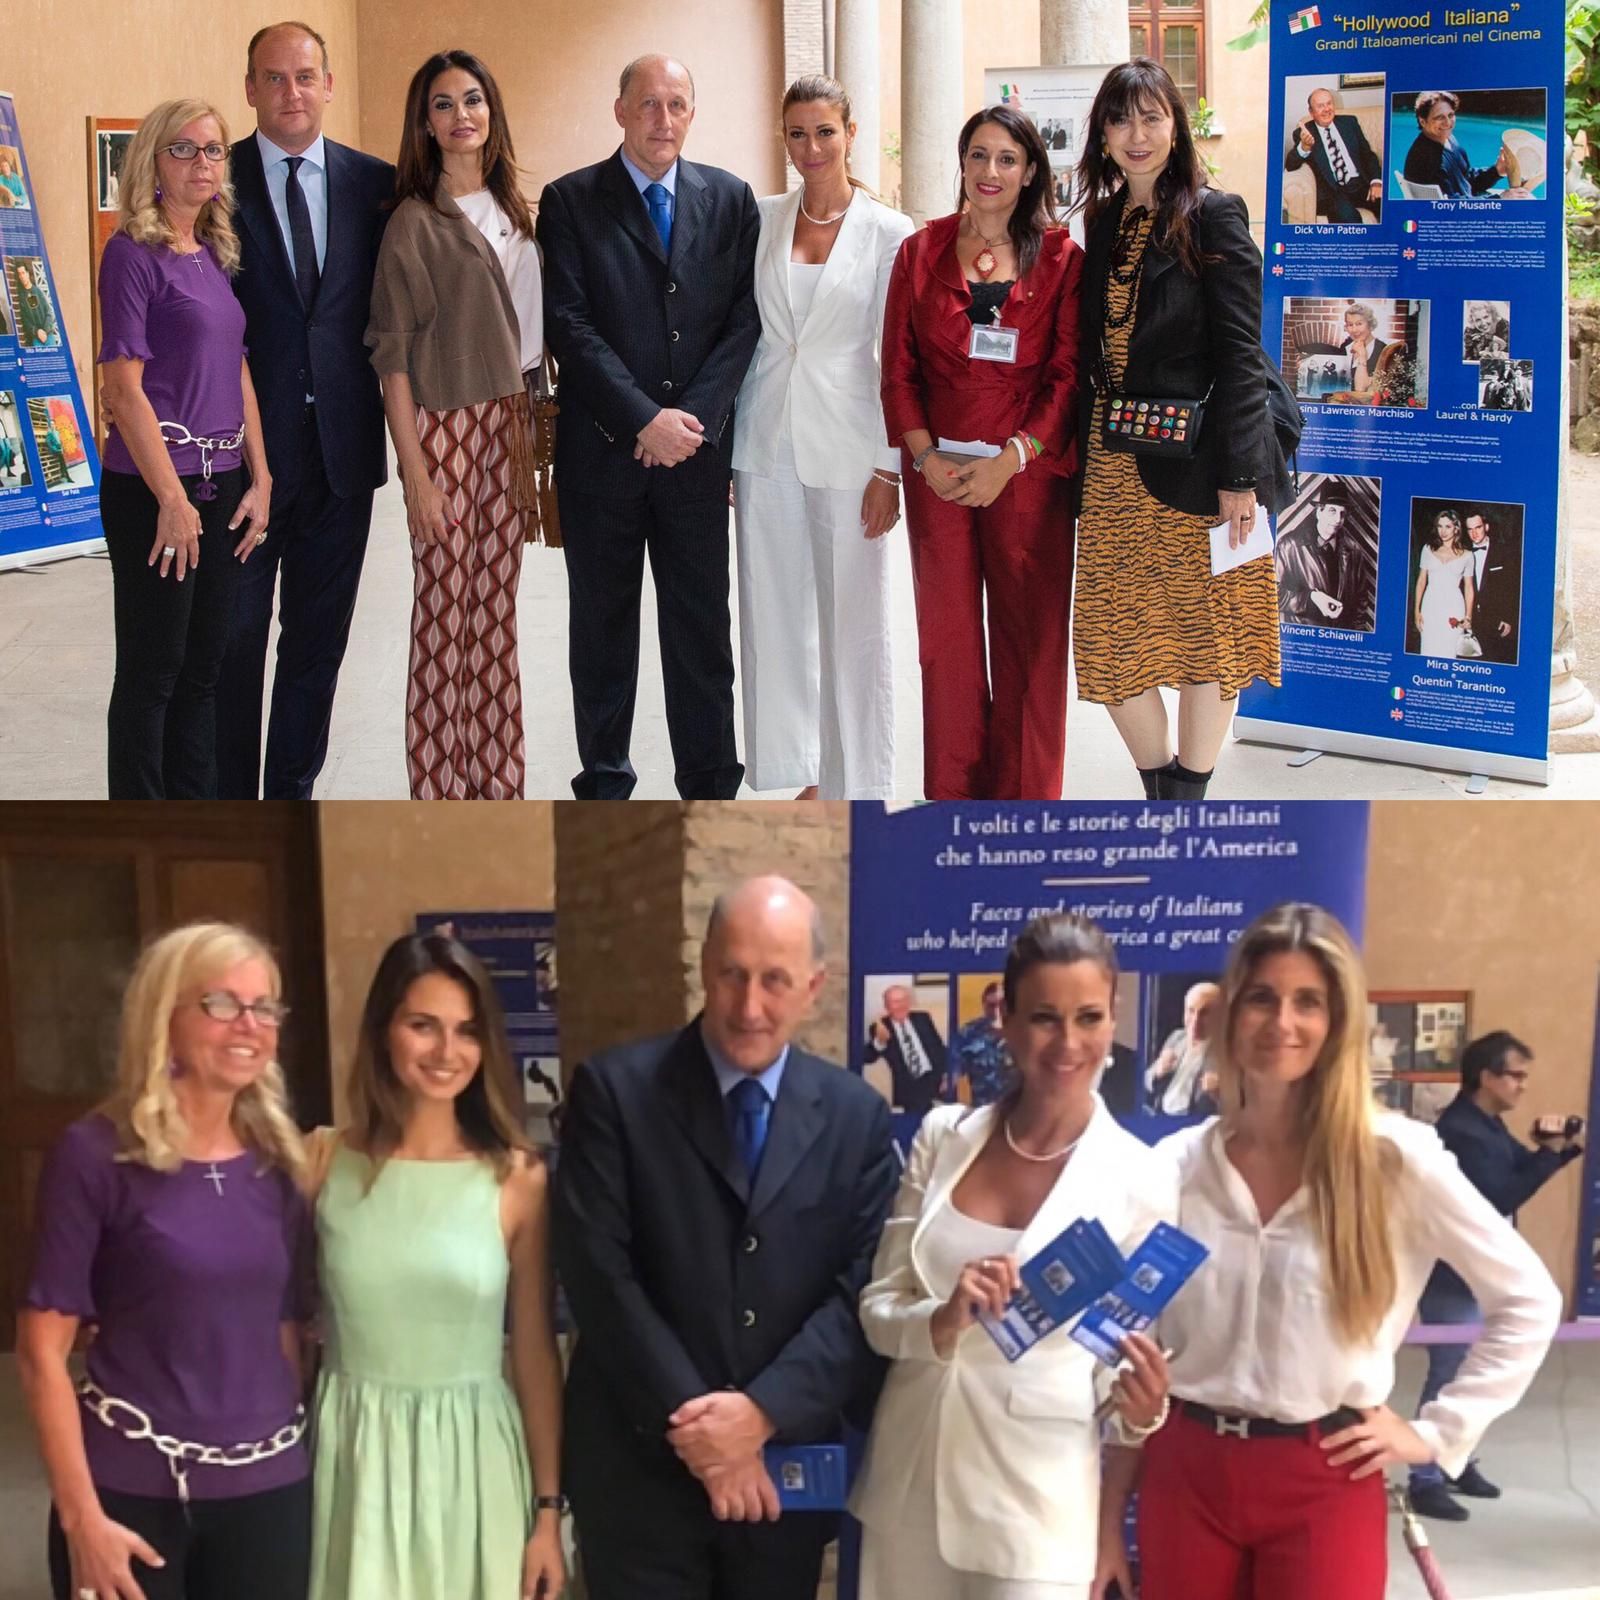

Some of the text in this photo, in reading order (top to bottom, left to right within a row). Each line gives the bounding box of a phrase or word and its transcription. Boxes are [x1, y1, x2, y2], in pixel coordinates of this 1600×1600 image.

[1315, 28, 1542, 51] Grandi Italoamericani nel Cinema
[1430, 201, 1502, 211] Tony Musante
[1294, 225, 1367, 234] Dick Van Patten
[1300, 405, 1415, 419] sina Lawrence Marchisio
[1436, 410, 1513, 424] Laurel & Hardy
[1281, 624, 1364, 642] Vincent Schiavelli
[1426, 659, 1492, 675] Mira Sorvino
[1412, 675, 1506, 694] Quentin Tarantino
[953, 804, 1281, 836] I volti e le storie degli Italiani
[936, 844, 972, 866] che
[978, 844, 1047, 865] hanno
[1052, 847, 1098, 862] reso
[1102, 838, 1180, 868] grande
[970, 895, 1244, 923] Faces and stories of Italians
[906, 928, 945, 950] who
[949, 927, 1008, 956] helped
[1154, 931, 1166, 944] a
[1169, 927, 1221, 950] great
